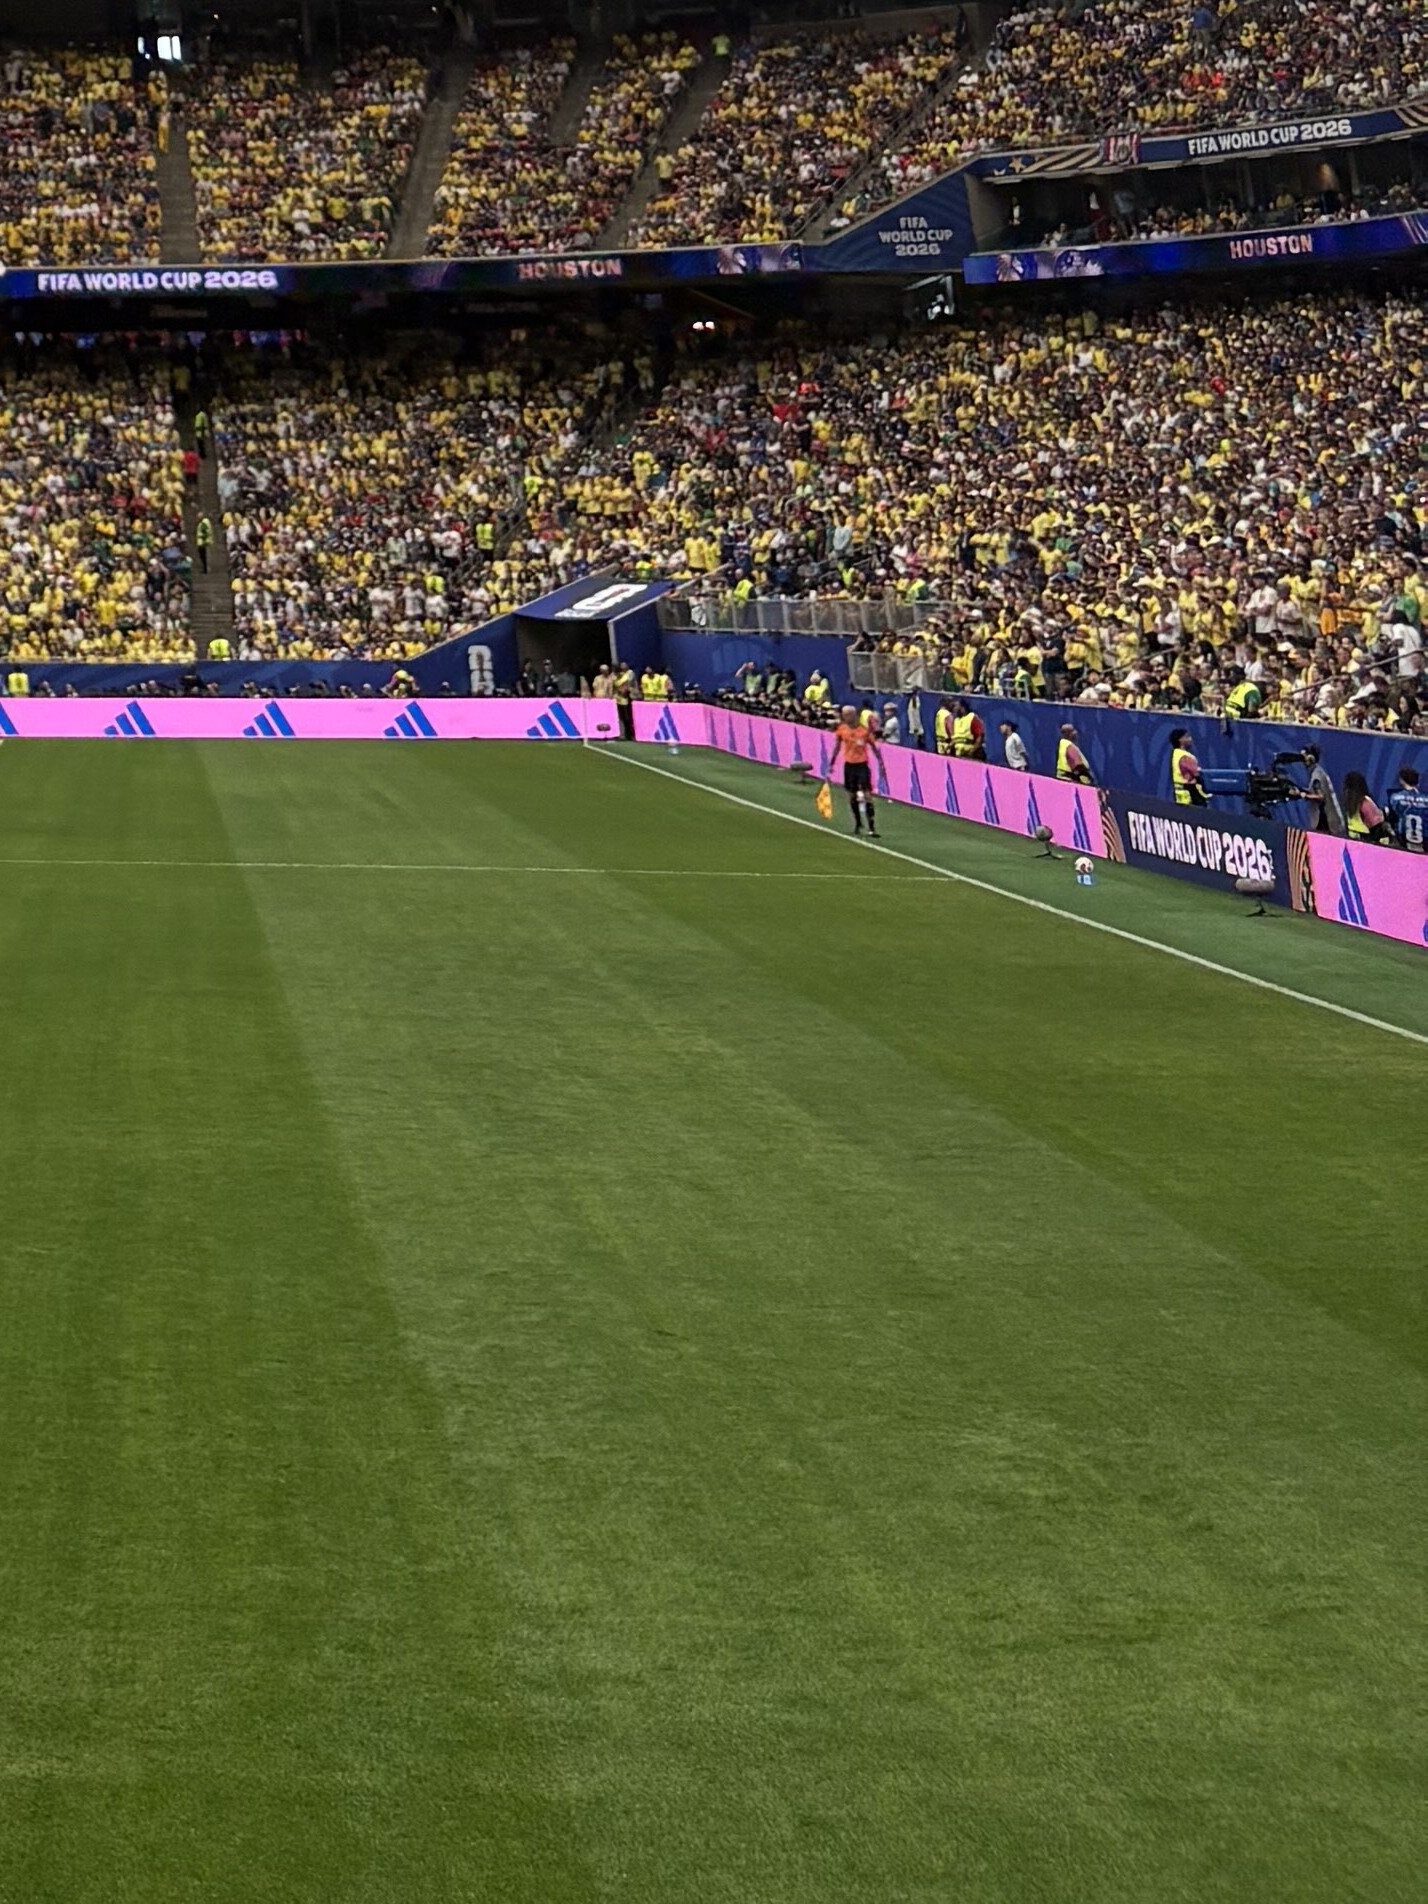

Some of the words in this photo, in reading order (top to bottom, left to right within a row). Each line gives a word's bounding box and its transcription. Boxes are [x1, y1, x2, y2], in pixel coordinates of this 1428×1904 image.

[1188, 136, 1220, 155] FIFA
[1220, 130, 1271, 151] WORLD
[1271, 126, 1300, 147] CUP
[1300, 119, 1352, 140] 2026
[899, 217, 928, 229] FIFA
[879, 230, 926, 245] WORLD
[926, 229, 953, 243] CUP
[1230, 234, 1313, 259] HOUSTON
[895, 243, 942, 257] 2026
[38, 273, 83, 291] FIFA
[84, 272, 159, 290] WORLD
[160, 271, 203, 289] CUP
[204, 270, 279, 288] 2026
[1128, 811, 1157, 853] FIFA
[1155, 816, 1197, 866] WORLD
[1197, 826, 1222, 872] CUP
[1223, 832, 1272, 882] 2026
